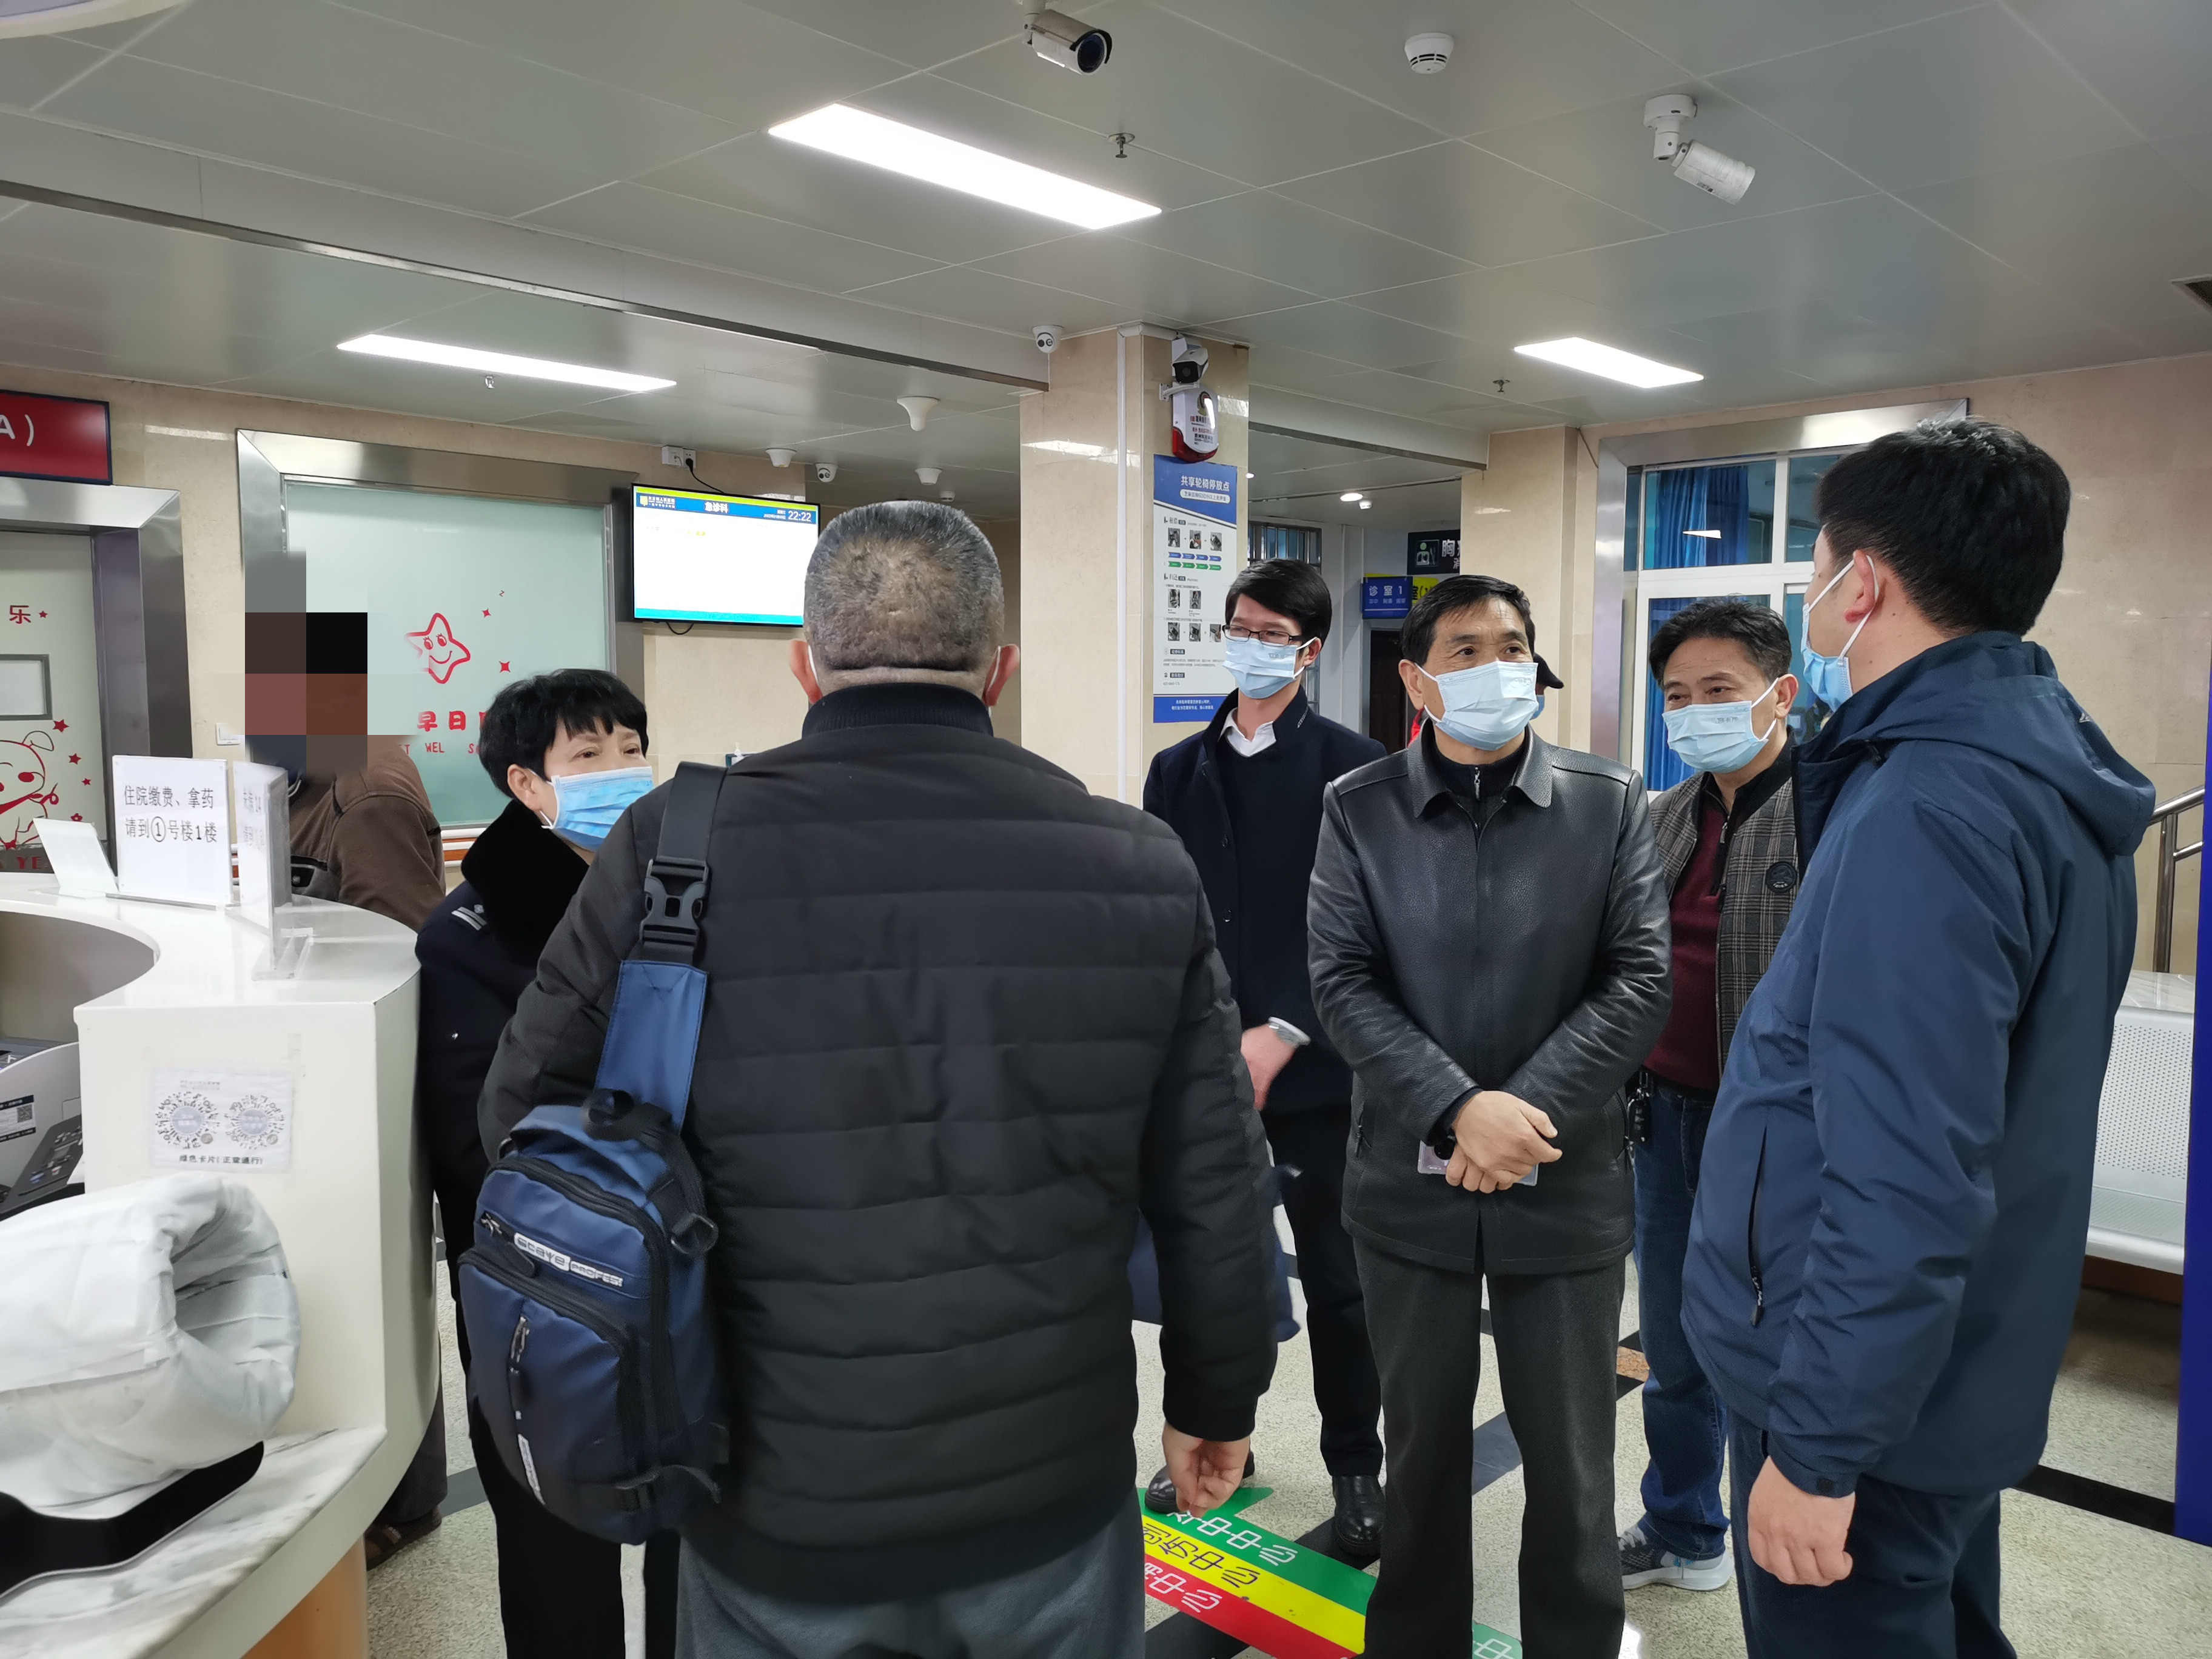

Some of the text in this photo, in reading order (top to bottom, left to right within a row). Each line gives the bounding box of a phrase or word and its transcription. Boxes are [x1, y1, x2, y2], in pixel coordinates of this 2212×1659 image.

[1181, 475, 1230, 492] 共享轮椅停放点
[788, 511, 811, 522] 22:22
[9, 605, 31, 624] 乐
